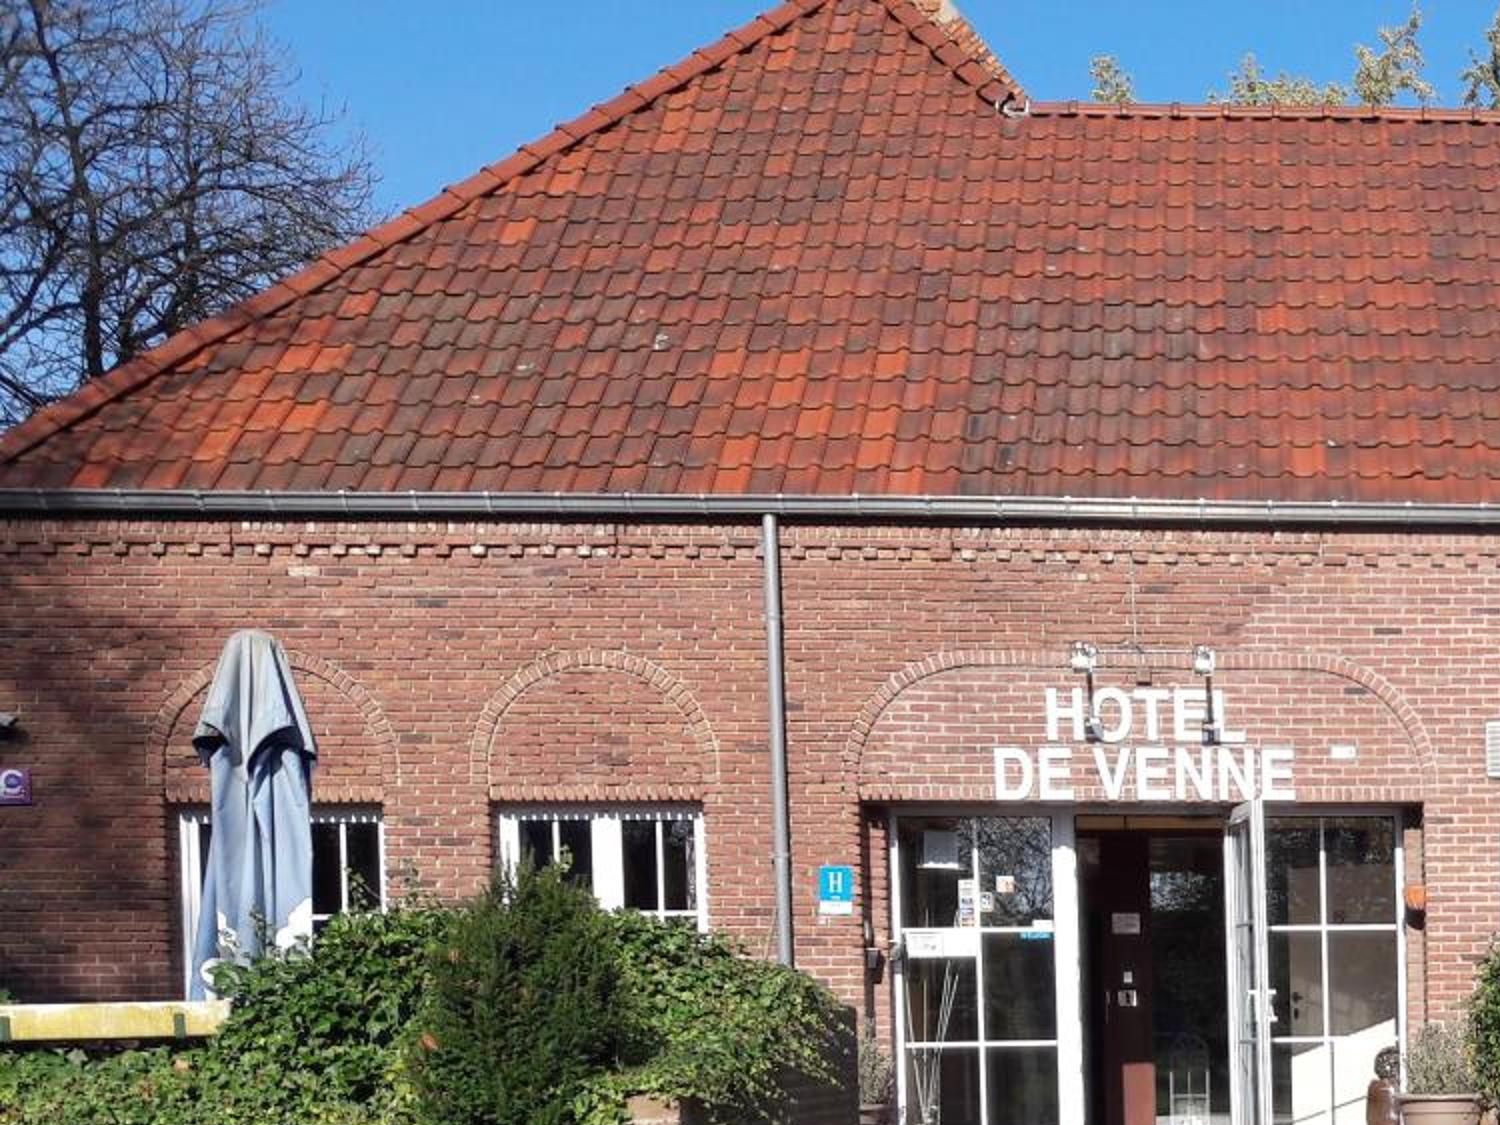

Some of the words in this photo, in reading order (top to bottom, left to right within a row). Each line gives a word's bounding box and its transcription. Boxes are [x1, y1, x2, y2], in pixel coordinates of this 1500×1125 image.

[1045, 687, 1247, 743] HOTEL
[993, 747, 1075, 801] DE
[1093, 747, 1297, 801] VENNE
[828, 871, 843, 894] H
